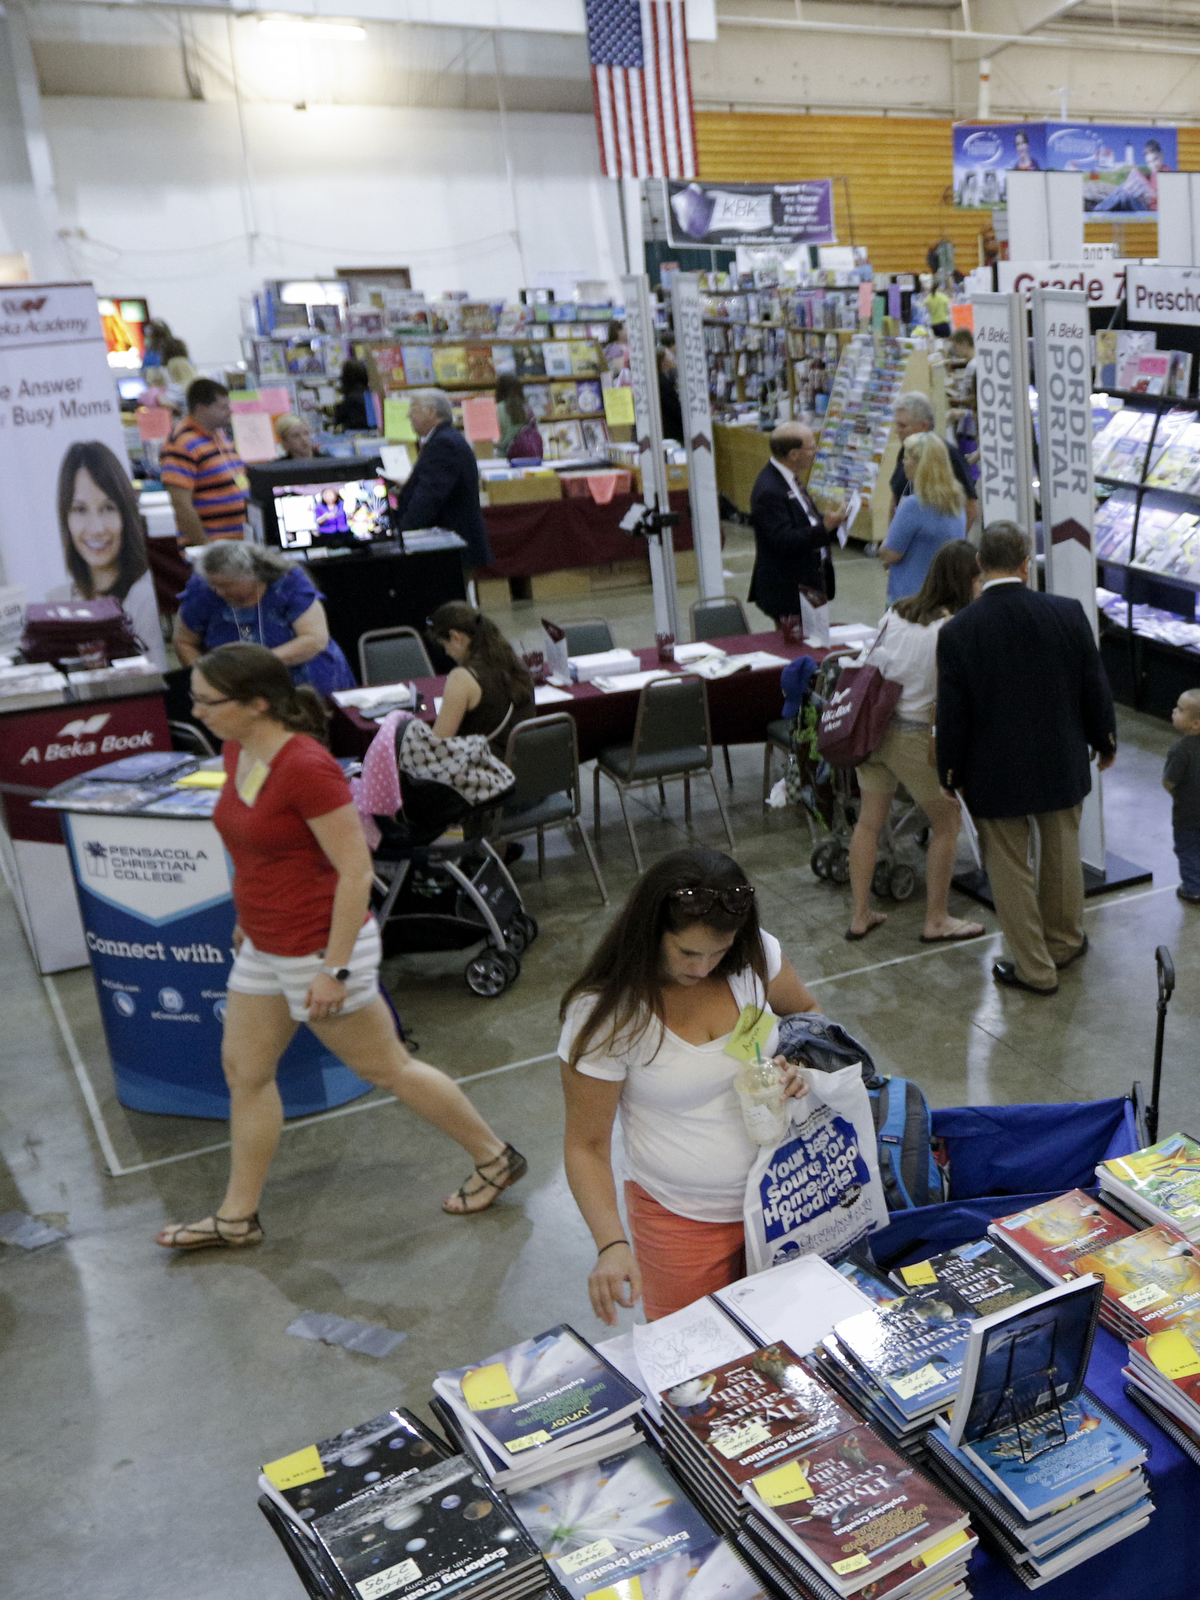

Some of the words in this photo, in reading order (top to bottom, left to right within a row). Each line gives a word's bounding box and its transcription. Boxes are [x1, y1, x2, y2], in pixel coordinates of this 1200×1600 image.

[722, 199, 761, 217] KBK
[26, 318, 88, 335] Academy
[977, 326, 985, 341] A
[1047, 323, 1056, 337] A
[1059, 323, 1084, 339] Beka
[18, 378, 82, 399] Answer
[12, 405, 54, 428] Busy
[60, 399, 111, 419] Moms
[977, 348, 1000, 504] PORTAL
[996, 349, 1015, 501] ORDER
[1048, 344, 1069, 498] PORTAL
[1066, 344, 1088, 495] ORDER
[20, 746, 41, 766] A
[44, 740, 97, 762] Beka
[101, 730, 155, 754] Book
[109, 845, 208, 861] PENSACOLA
[111, 858, 197, 872] CHRISTIAN
[113, 869, 184, 883] COLLEGE
[85, 931, 167, 961] Connect
[170, 942, 226, 964] with
[765, 1148, 805, 1184] Your
[1149, 1180, 1184, 1196] Creation
[1050, 1239, 1079, 1254] Creation
[1078, 1227, 1108, 1243] Exploring
[979, 1283, 1014, 1301] Exploring
[1141, 1299, 1186, 1322] Creation
[546, 1377, 586, 1401] Exploring
[708, 1369, 766, 1402] Fifth
[726, 1367, 751, 1386] Day
[510, 1395, 548, 1413] Creation
[725, 1395, 749, 1409] the
[752, 1386, 767, 1398] of
[550, 1403, 590, 1430] junior
[765, 1427, 794, 1445] Zoology
[787, 1415, 840, 1445] Exploring
[738, 1440, 787, 1466] Creation
[812, 1458, 835, 1472] Day
[1052, 1446, 1112, 1482] ZOOLOGY
[378, 1467, 420, 1493] Exploring
[806, 1460, 850, 1484] Fifth
[838, 1469, 852, 1480] of
[805, 1464, 887, 1507] Creatures
[811, 1476, 891, 1518] Flying
[333, 1491, 378, 1512] Creation
[868, 1494, 909, 1519] Exploring
[832, 1514, 869, 1537] Creation
[840, 1502, 928, 1553] NOTEBOOKING
[850, 1506, 903, 1539] JOURNAL
[866, 1514, 926, 1550] ZOOLOGY
[629, 1530, 690, 1561] Exploring
[441, 1546, 508, 1585] Exploring
[452, 1555, 473, 1571] with
[573, 1556, 630, 1585] Creation
[364, 1563, 411, 1590] 27.95
[393, 1574, 442, 1600] Crea
[403, 1563, 452, 1593] Astronomy
